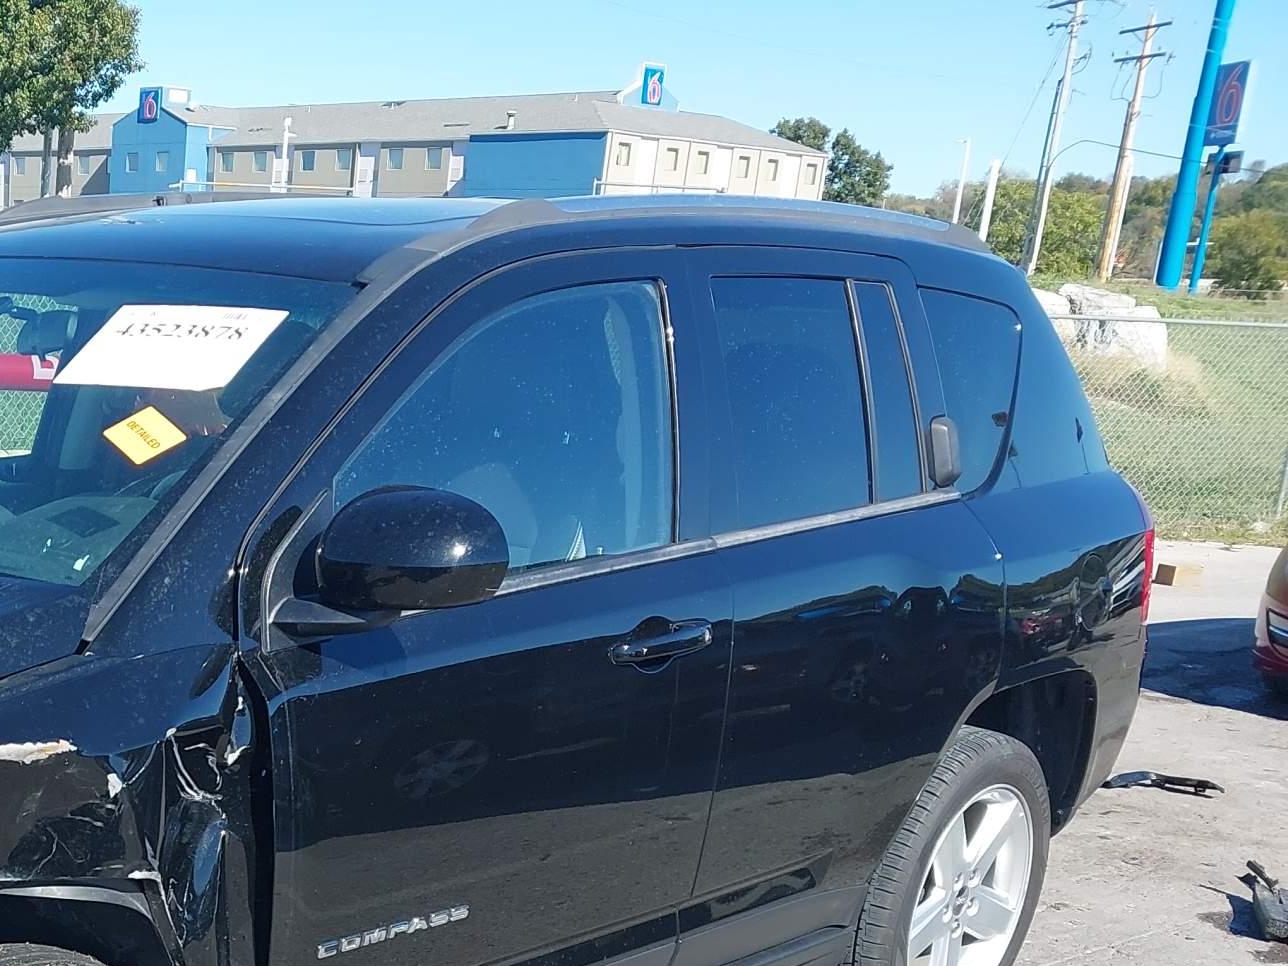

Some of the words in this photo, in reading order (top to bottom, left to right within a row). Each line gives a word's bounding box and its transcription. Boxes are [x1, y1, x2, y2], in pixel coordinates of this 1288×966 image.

[648, 71, 661, 104] 6
[1217, 63, 1244, 126] 6
[144, 91, 156, 120] 6
[116, 322, 249, 340] 43523878
[126, 420, 161, 449] DETAILED
[316, 904, 470, 959] COMPASS
